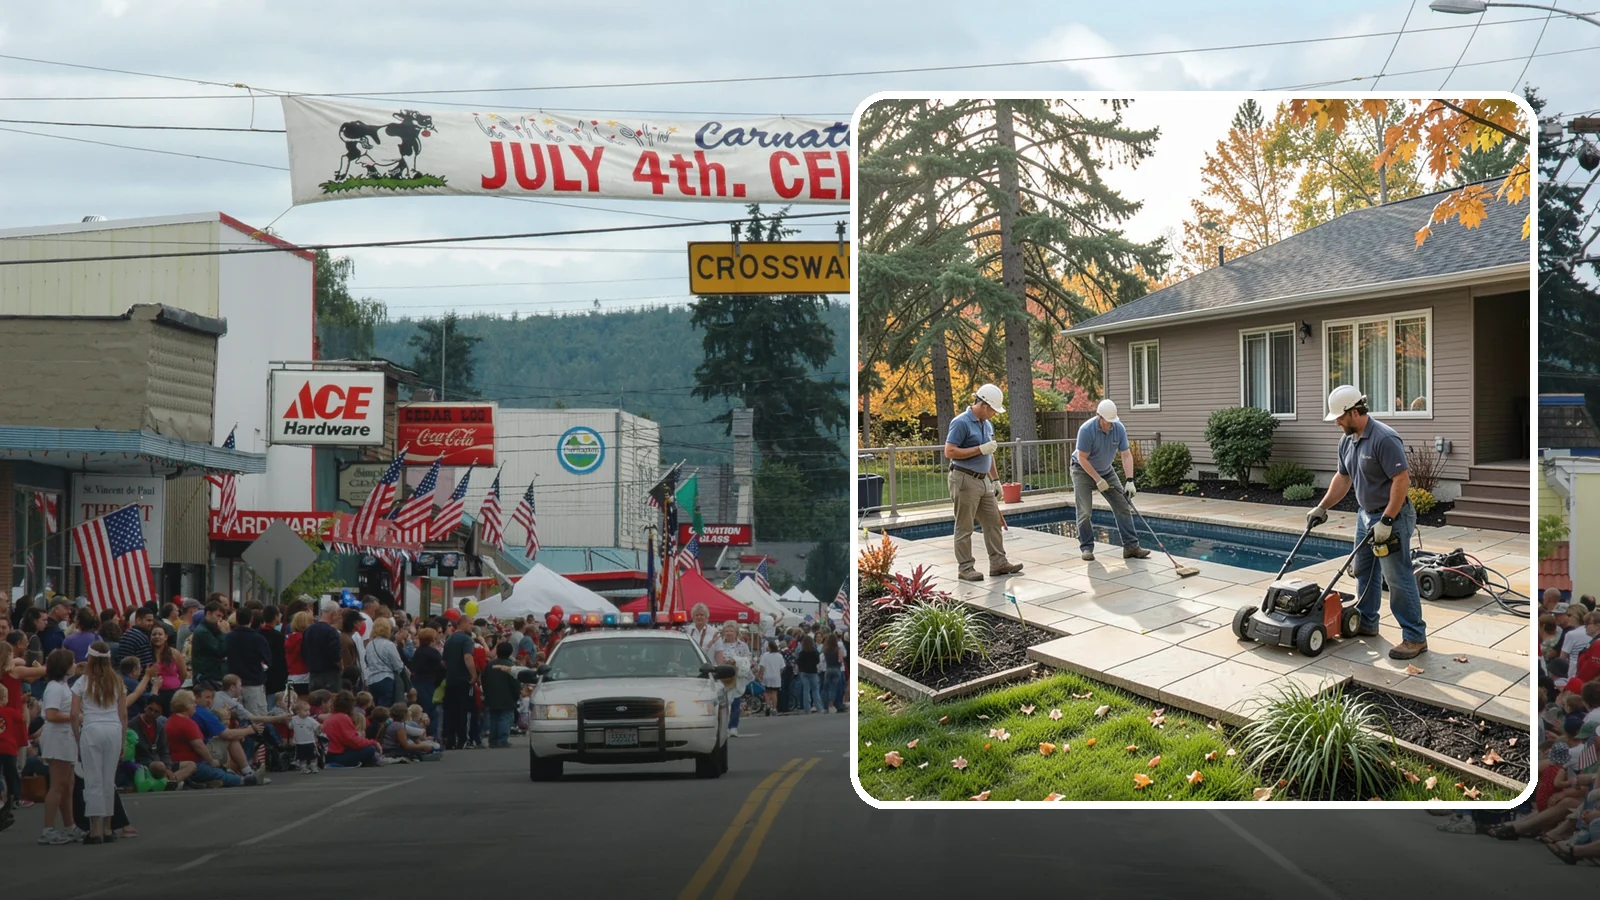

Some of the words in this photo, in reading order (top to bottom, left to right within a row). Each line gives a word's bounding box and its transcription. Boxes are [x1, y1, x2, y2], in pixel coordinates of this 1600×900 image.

[695, 121, 850, 150] Carnat
[481, 141, 605, 192] JULY
[632, 150, 746, 198] 4th.
[697, 254, 850, 280] CROSSWA
[283, 380, 373, 420] ACE
[405, 409, 452, 422] CEDAR
[283, 421, 370, 437] Hardware
[416, 428, 477, 447] Coca-Cola
[353, 467, 385, 480] Simpl
[96, 485, 124, 495] Vincent
[126, 486, 136, 495] de
[137, 486, 155, 496] Paul
[212, 516, 331, 536] HARDARE
[688, 526, 741, 535] CRNATION
[699, 535, 730, 543] GLASS
